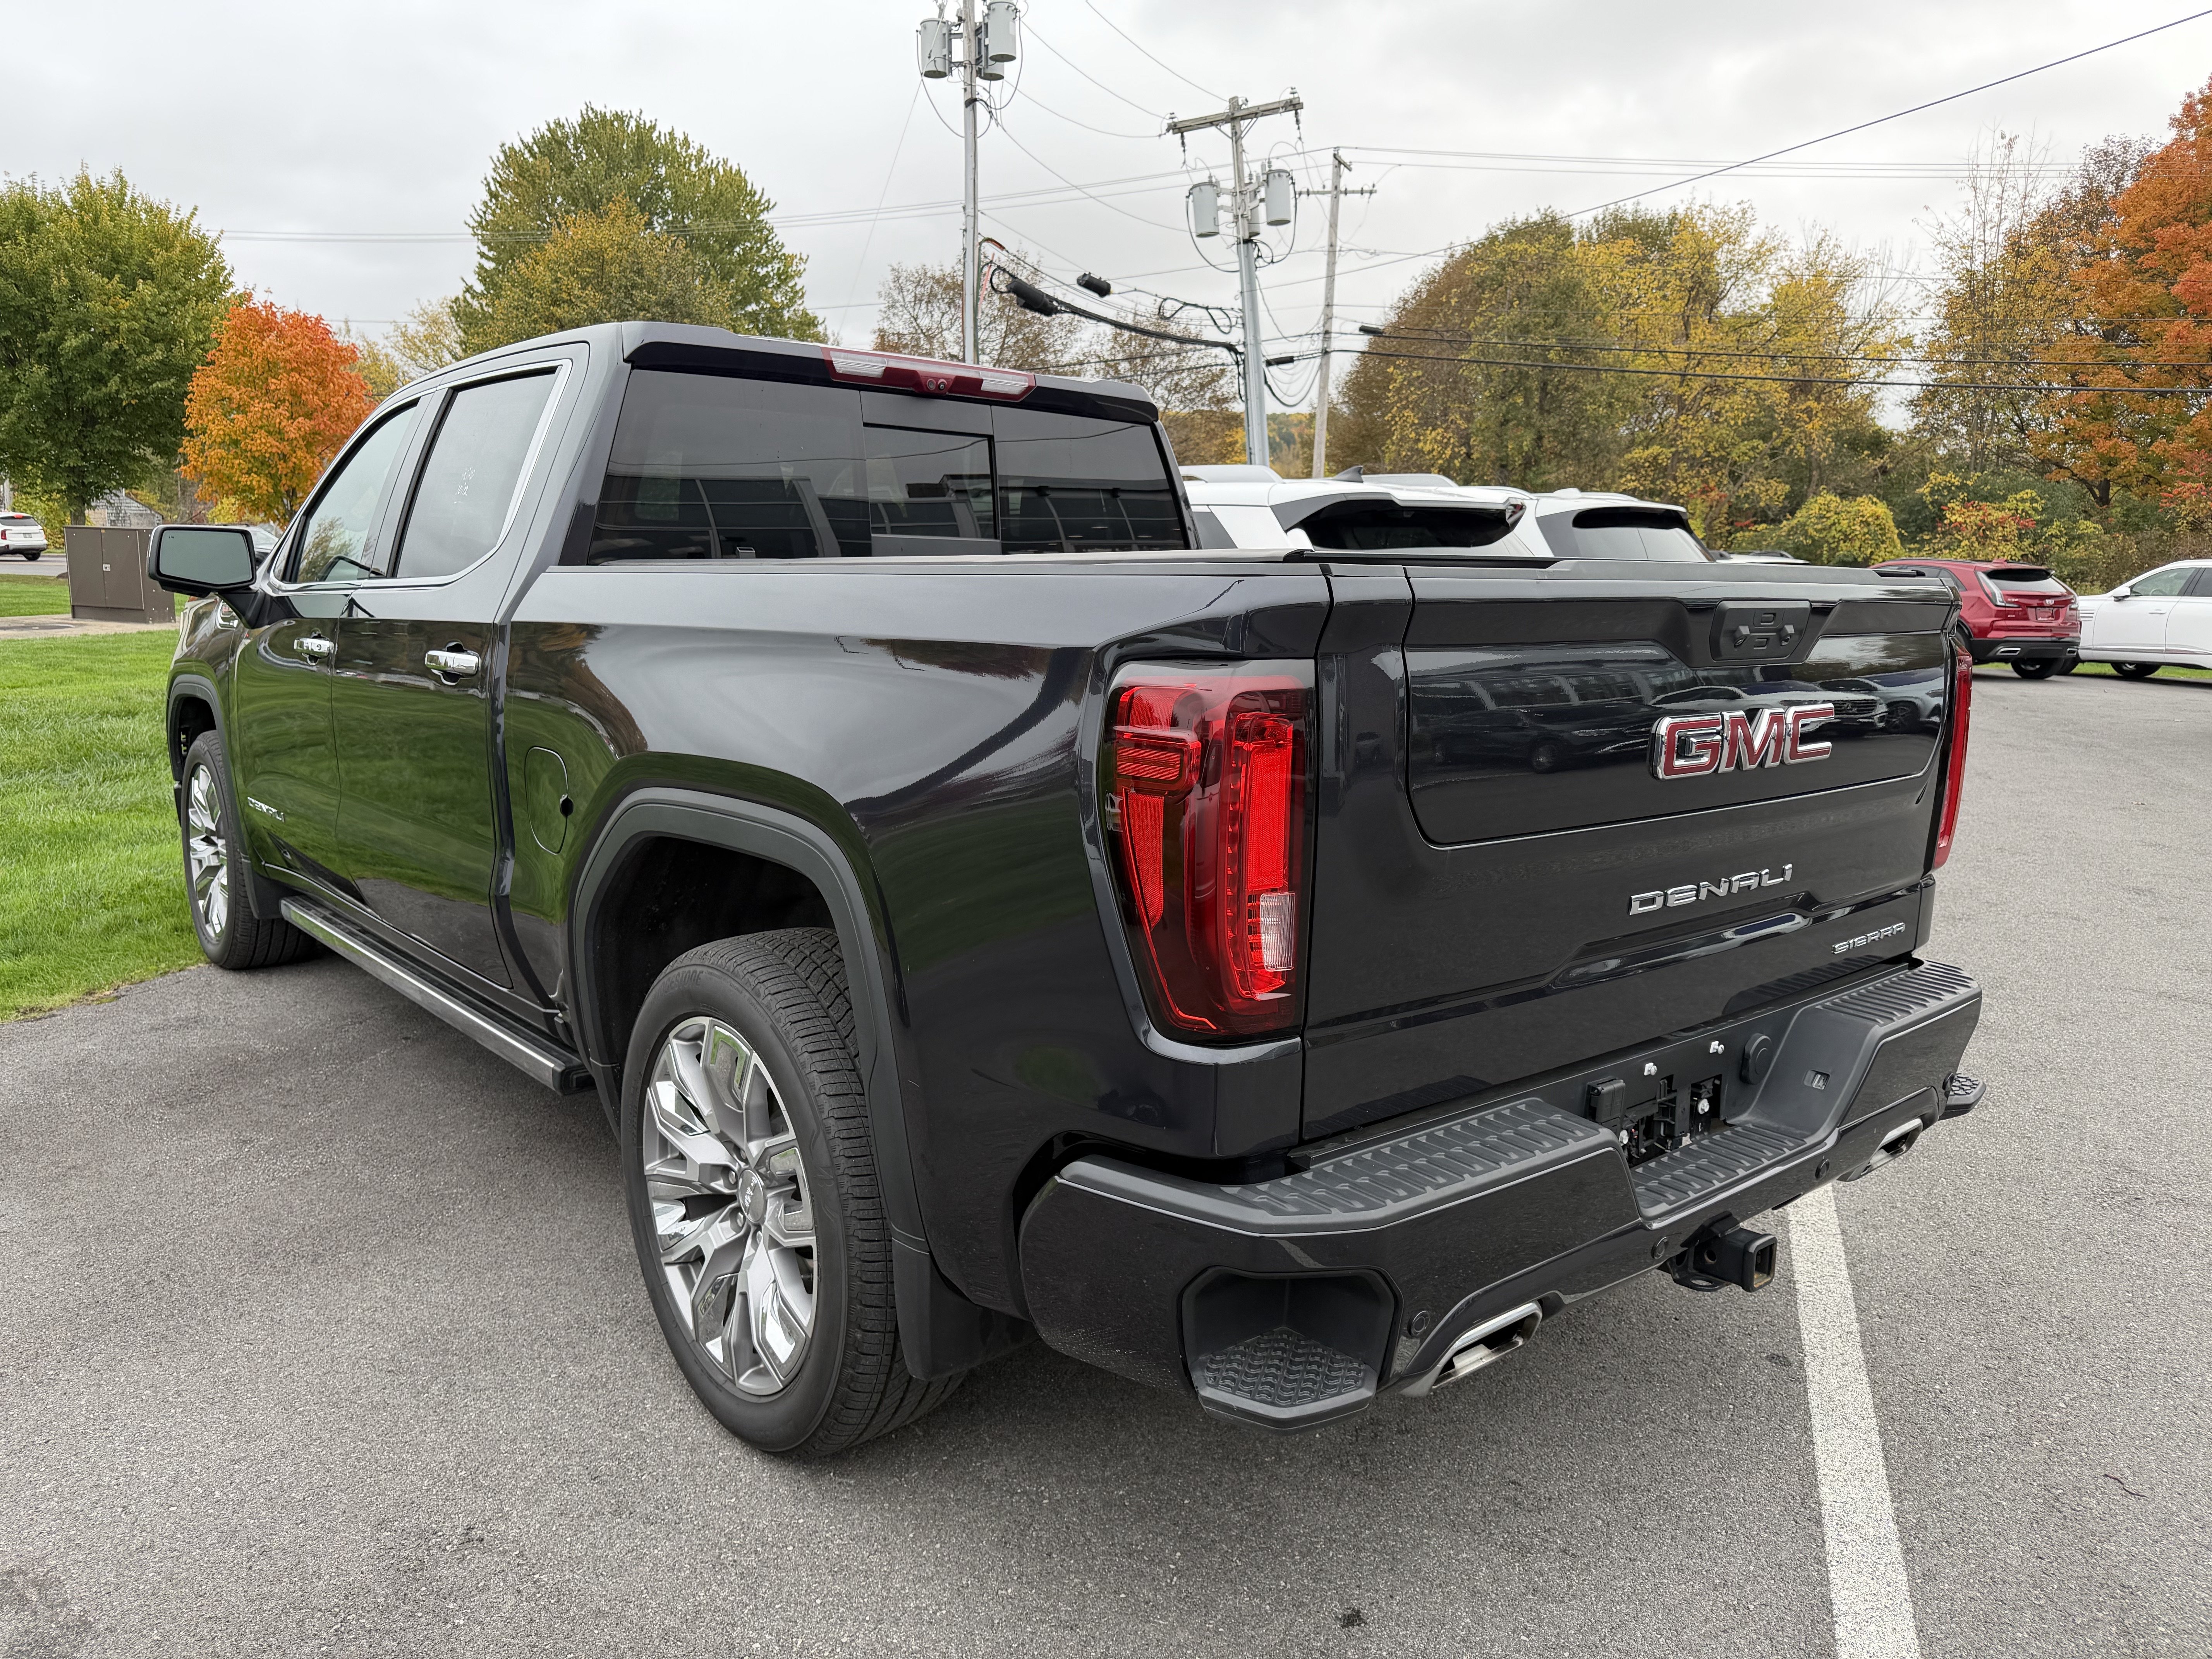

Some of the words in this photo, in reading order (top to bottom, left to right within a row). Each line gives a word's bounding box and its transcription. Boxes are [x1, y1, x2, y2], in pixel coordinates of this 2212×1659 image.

[1650, 702, 1835, 781] GMC
[1628, 863, 1793, 915] DENALI
[1831, 922, 1906, 954] SIERRA
